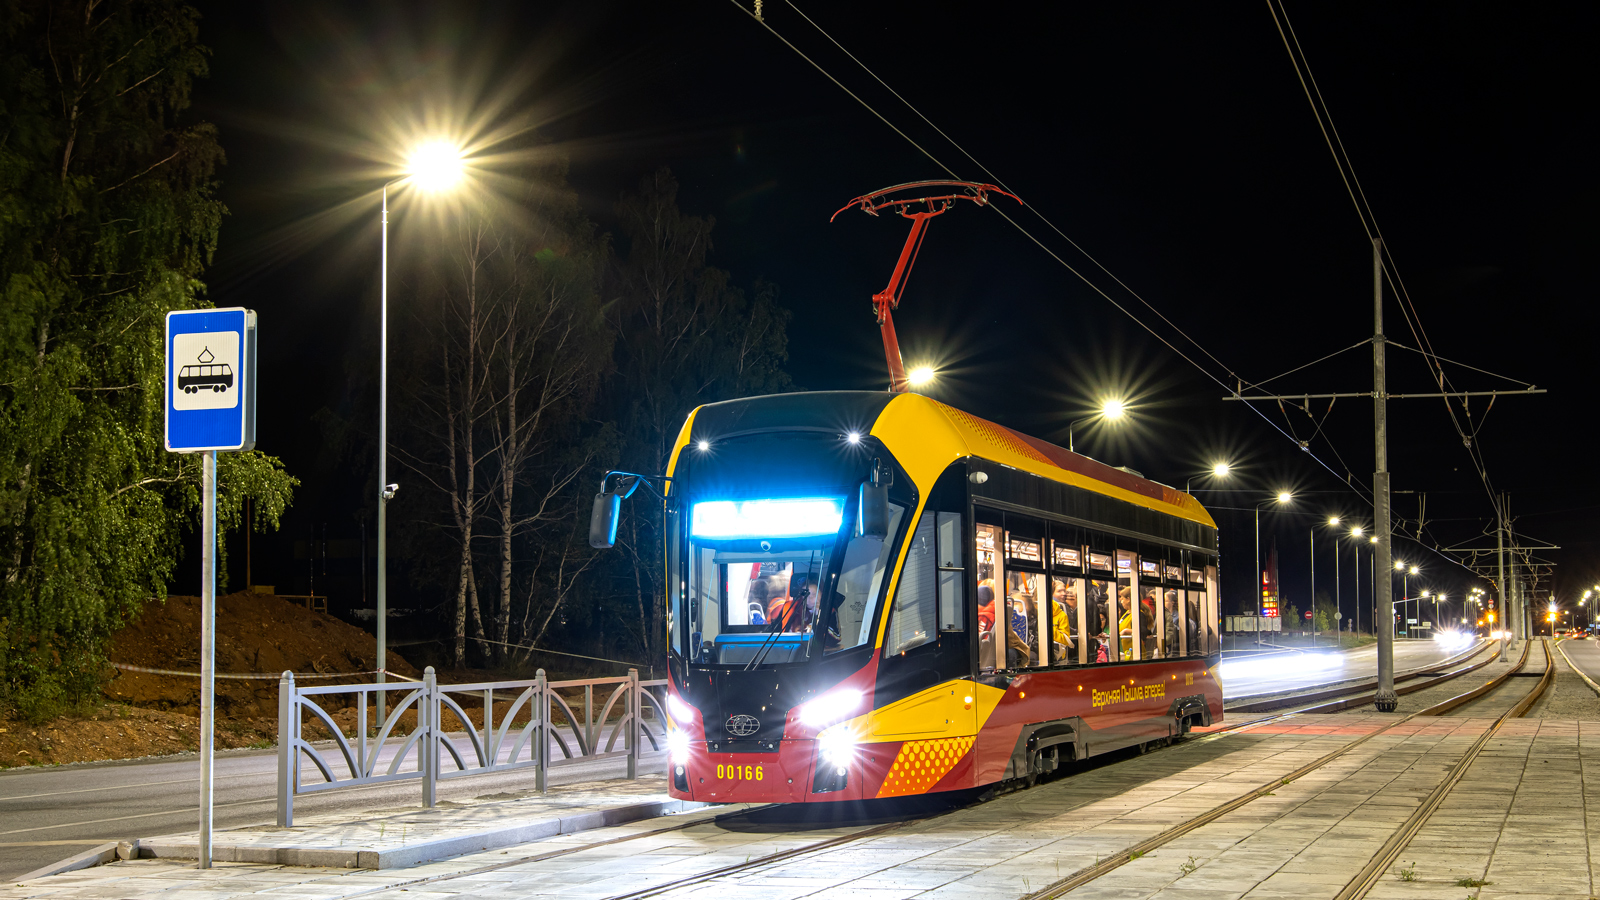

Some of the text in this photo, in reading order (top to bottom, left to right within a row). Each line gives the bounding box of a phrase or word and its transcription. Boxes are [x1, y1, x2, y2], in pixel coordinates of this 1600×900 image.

[1092, 688, 1120, 711] Верхняя
[1121, 684, 1144, 703] Пышма,
[717, 764, 763, 780] 00166
